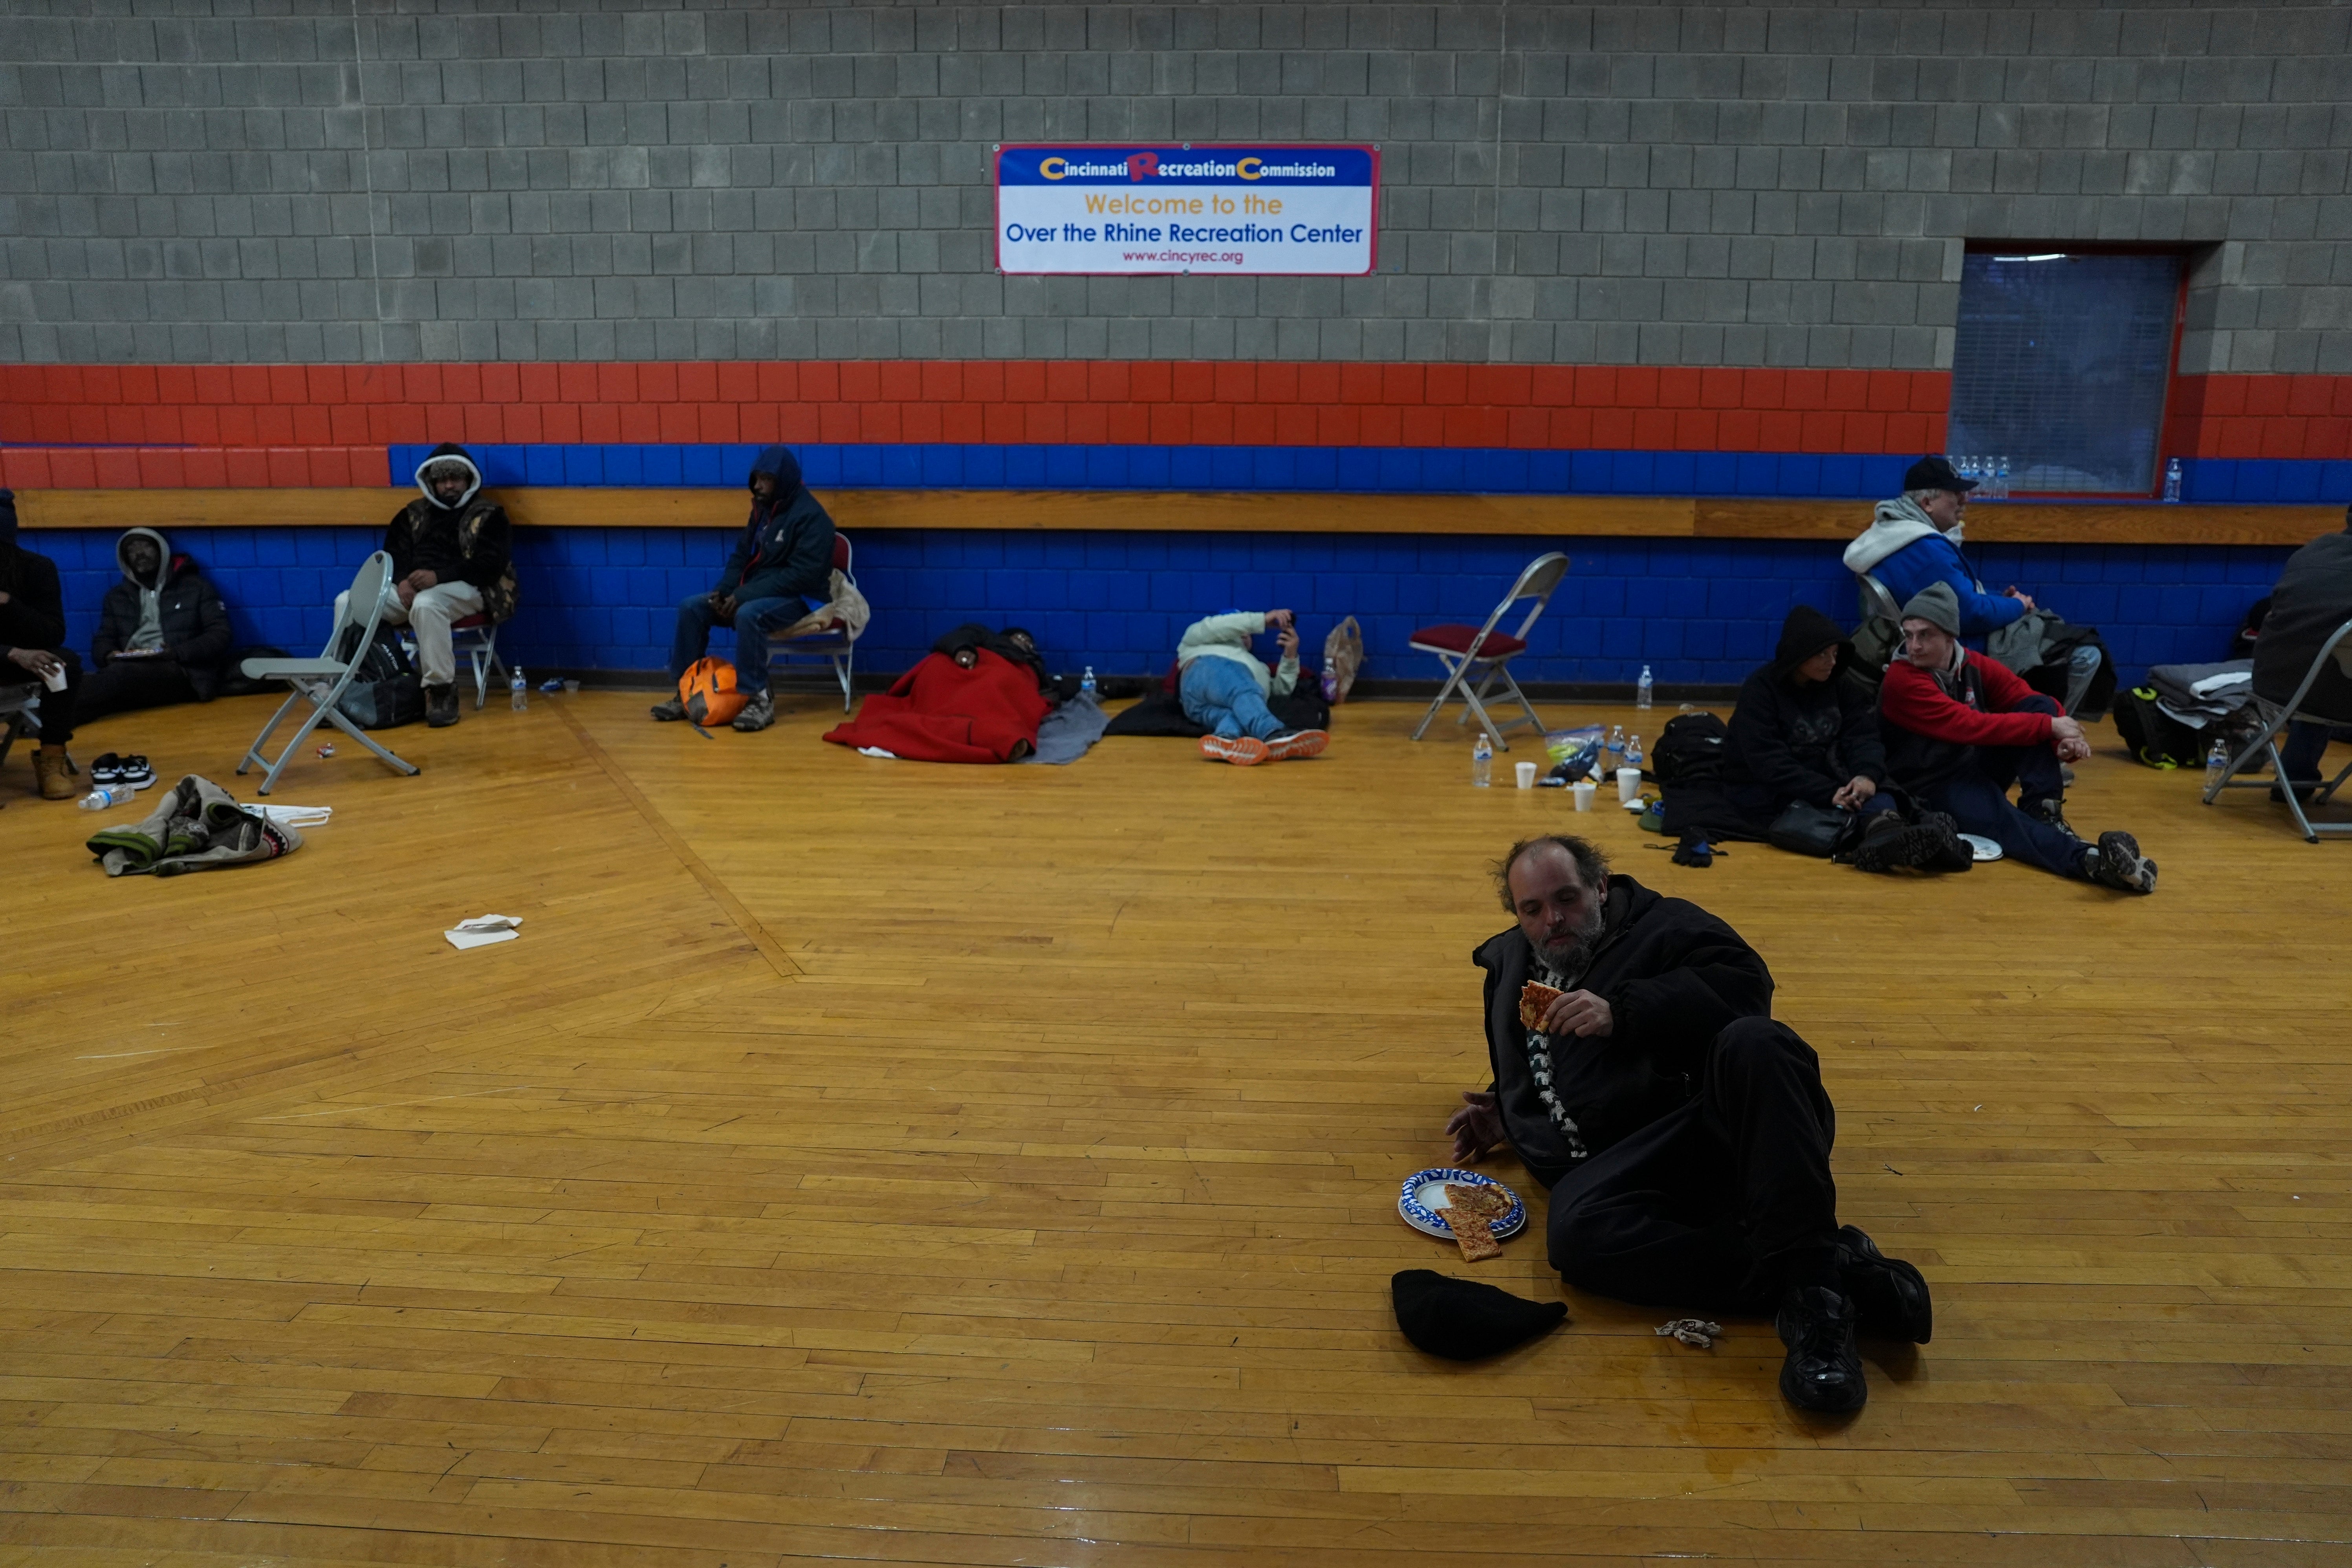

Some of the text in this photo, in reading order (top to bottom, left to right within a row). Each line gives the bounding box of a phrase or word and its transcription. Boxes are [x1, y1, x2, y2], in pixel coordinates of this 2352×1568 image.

[1040, 152, 1335, 182] Cincinnati Recreation Commission
[1085, 194, 1283, 214] Welcome to the
[1007, 223, 1363, 243] Over the Rhine Recreation Center
[1123, 249, 1244, 265] www.cincyrec.org
